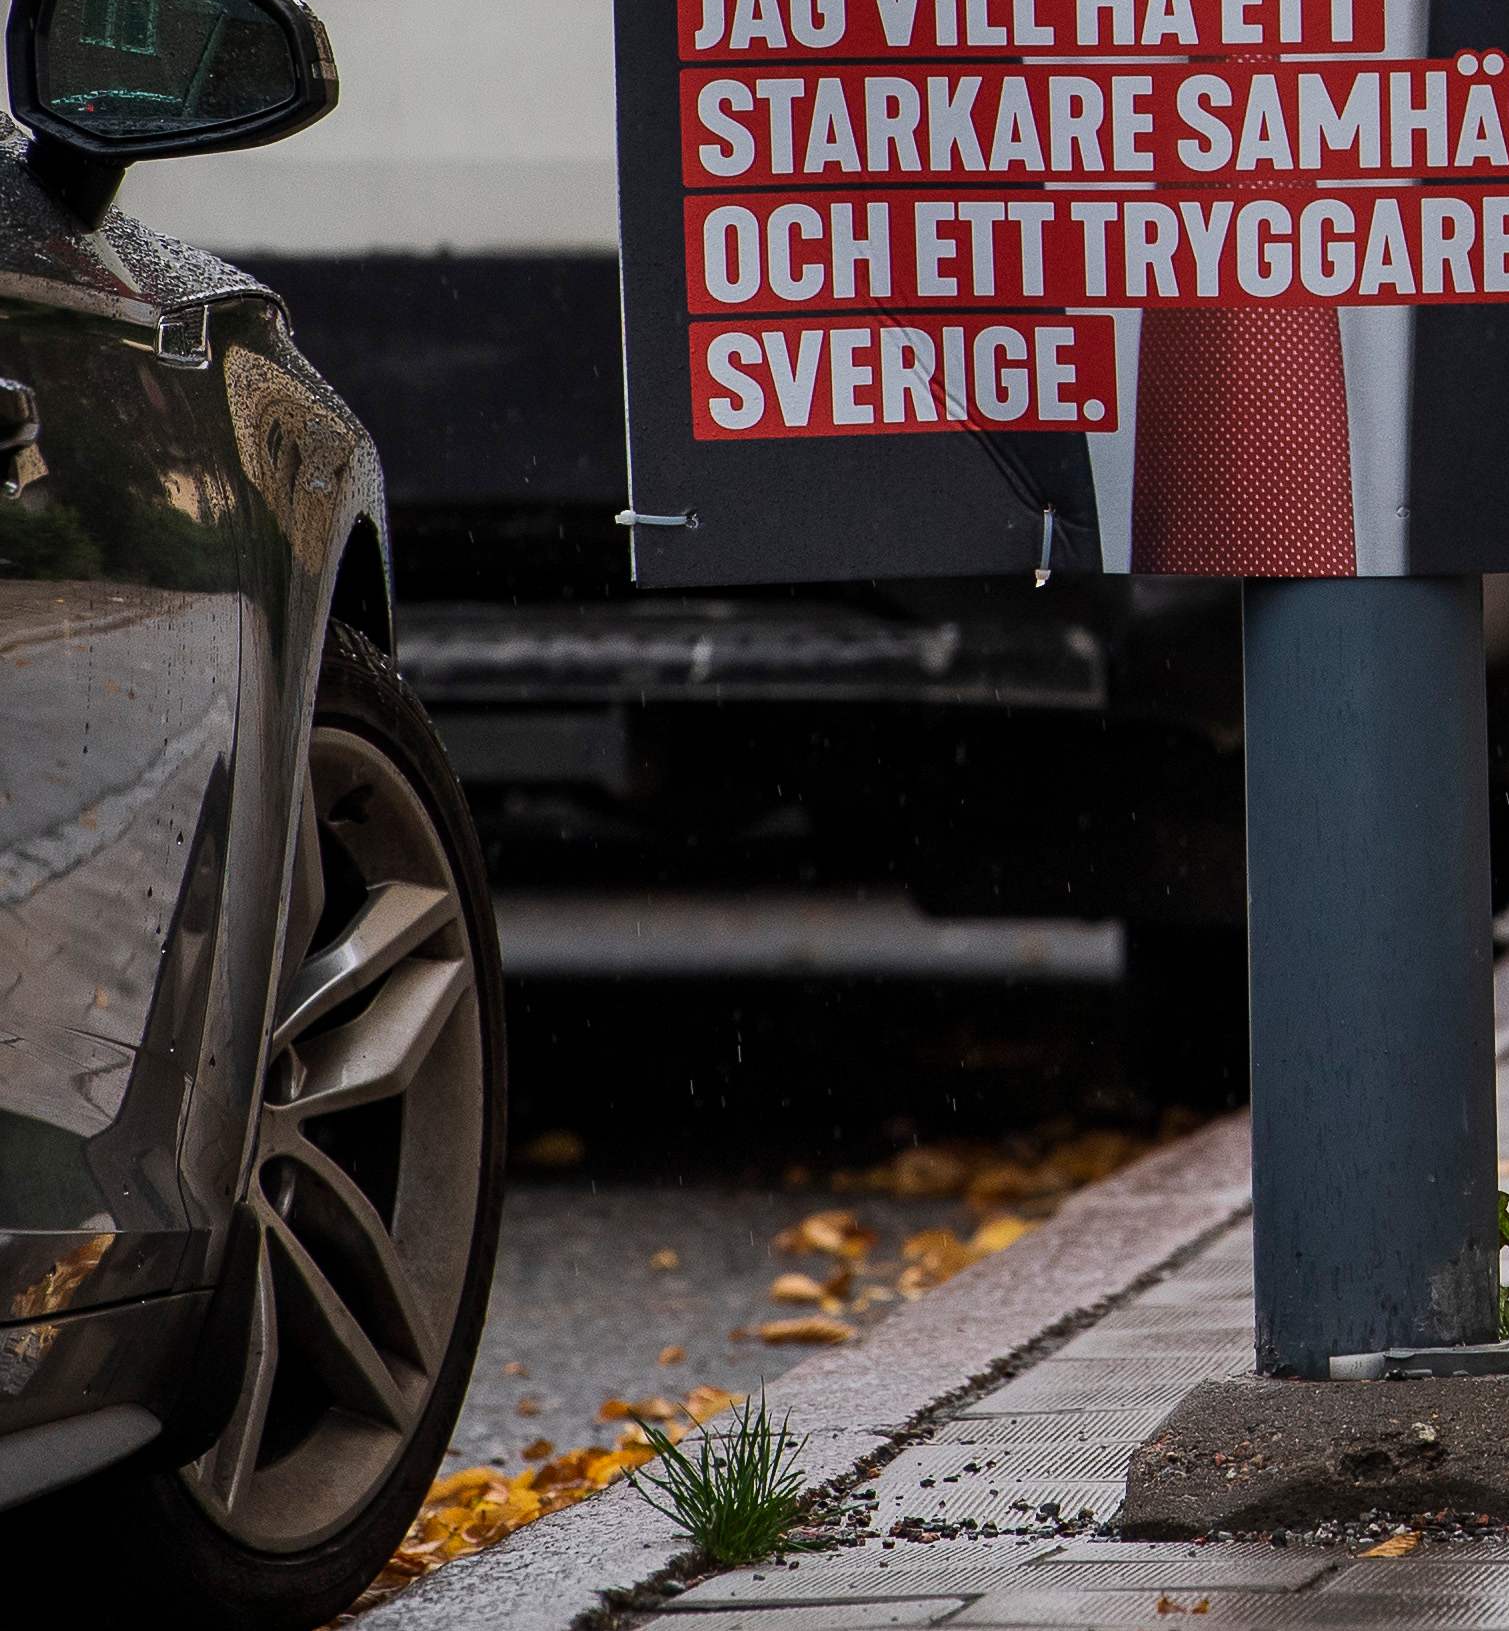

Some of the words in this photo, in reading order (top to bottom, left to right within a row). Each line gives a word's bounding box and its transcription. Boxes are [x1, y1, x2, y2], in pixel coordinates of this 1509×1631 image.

[697, 75, 1155, 177] STARKARE
[703, 202, 893, 304] OCH
[914, 201, 1056, 298] ETT
[707, 325, 1106, 430] SVERIGE.
